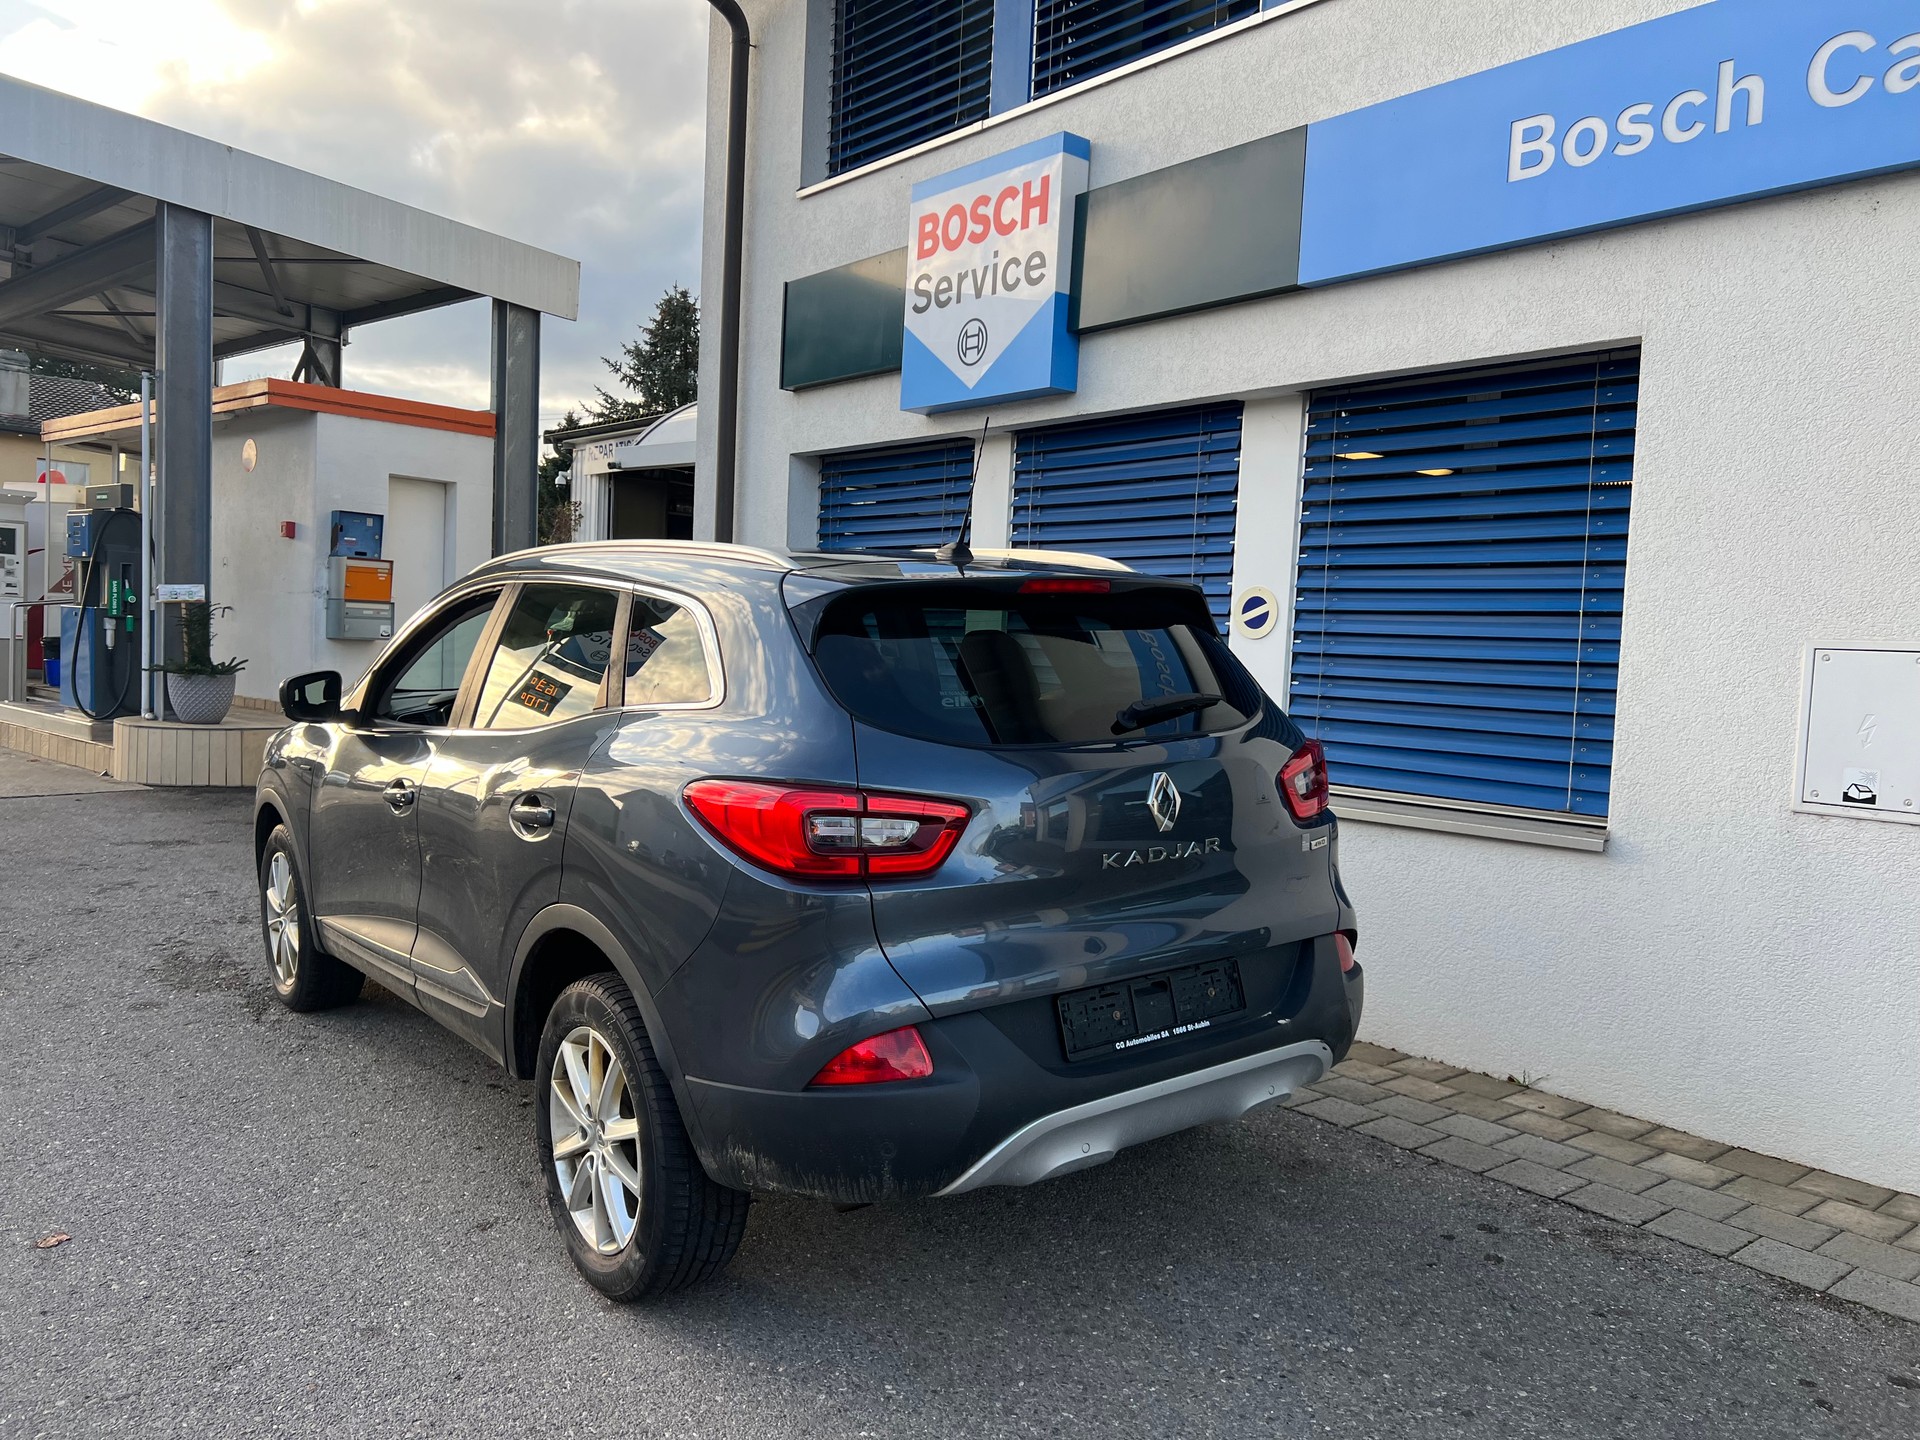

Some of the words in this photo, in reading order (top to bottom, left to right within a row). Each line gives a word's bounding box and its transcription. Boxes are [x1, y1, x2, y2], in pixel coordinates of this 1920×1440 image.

[1506, 57, 1765, 183] Bosch
[916, 174, 1050, 261] BOSCH
[911, 250, 1047, 314] Service
[1102, 837, 1220, 870] KADJAR
[1313, 838, 1326, 848] 4WD
[1125, 1033, 1161, 1048] Automobiles
[1160, 1030, 1170, 1039] SA
[1187, 1020, 1211, 1032] St-Aubin
